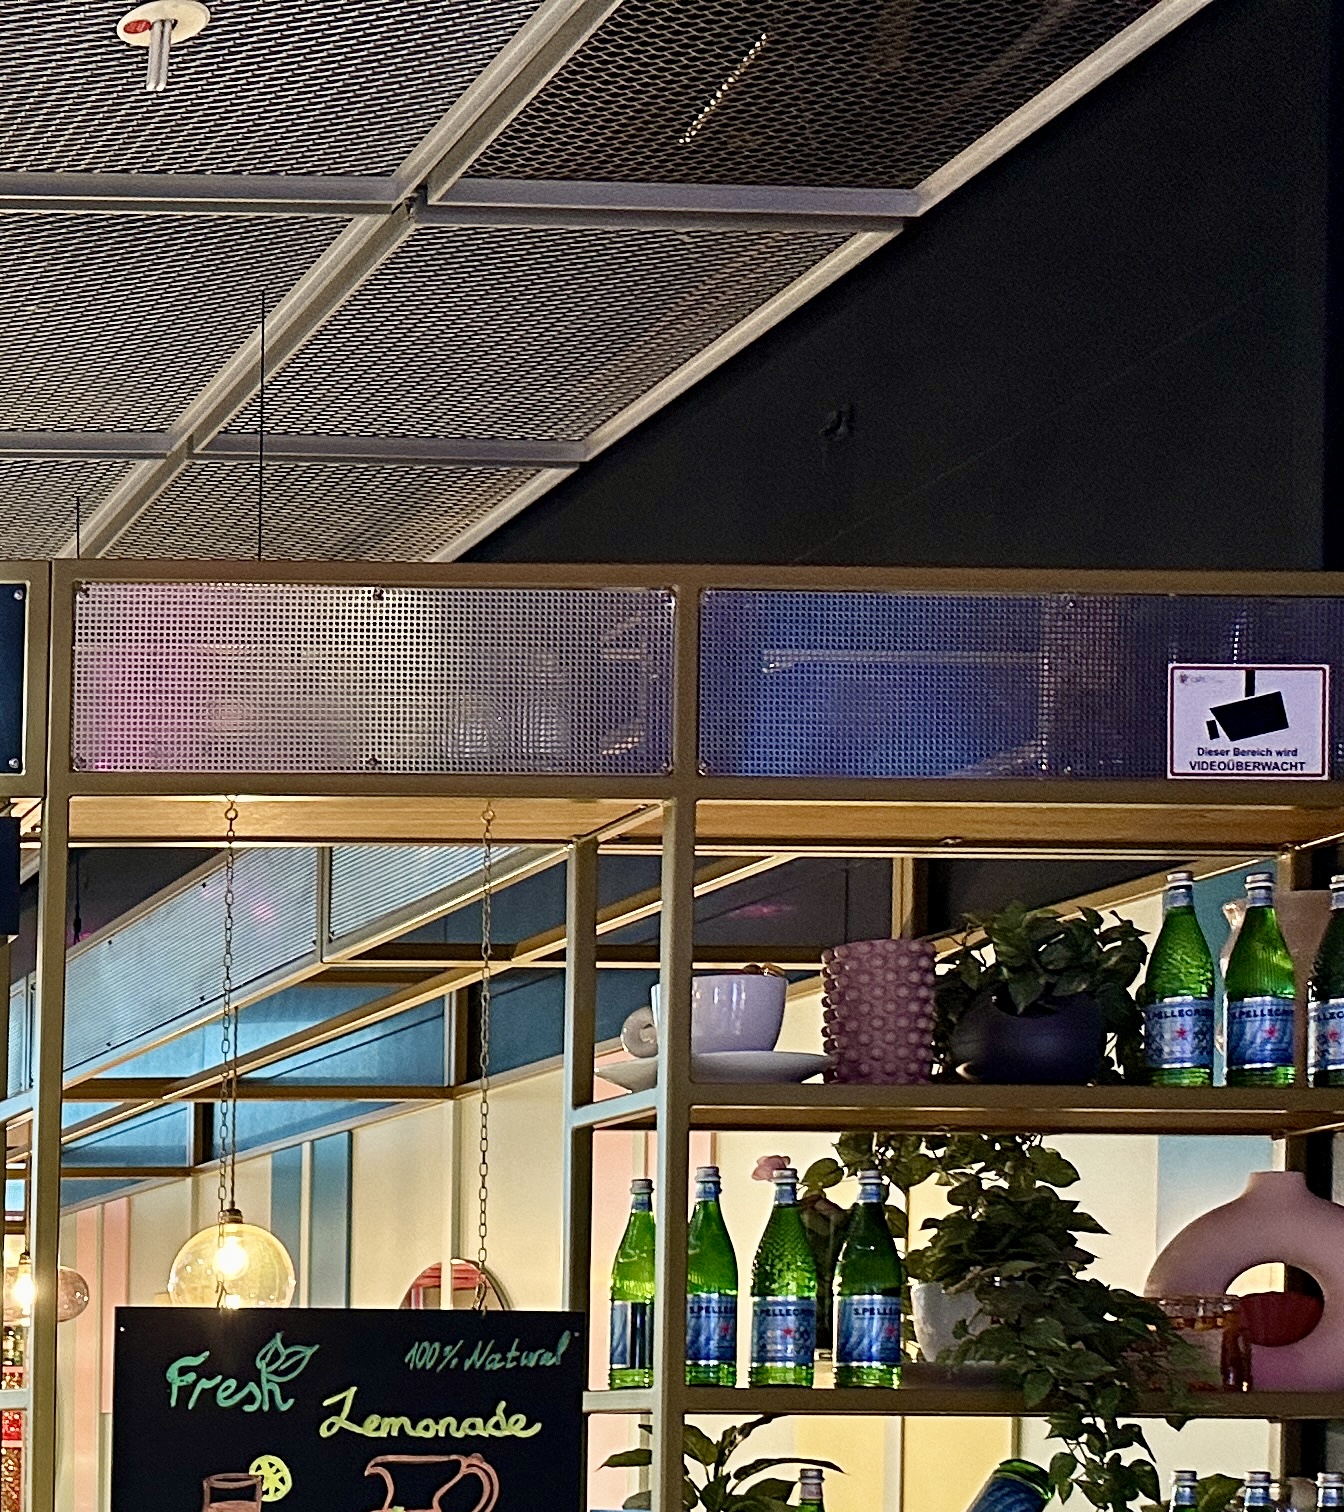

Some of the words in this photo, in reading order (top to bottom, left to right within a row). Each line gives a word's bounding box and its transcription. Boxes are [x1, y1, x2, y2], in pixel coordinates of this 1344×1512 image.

[1189, 759, 1306, 772] VIDEOÜBERWACHT
[1197, 747, 1229, 757] Dieser
[1233, 747, 1272, 757] Bereich
[1276, 747, 1298, 757] wird
[404, 1339, 460, 1373] 100%
[464, 1331, 570, 1371] Natural
[166, 1350, 294, 1411] Fresh
[319, 1386, 542, 1439] Lemonade
